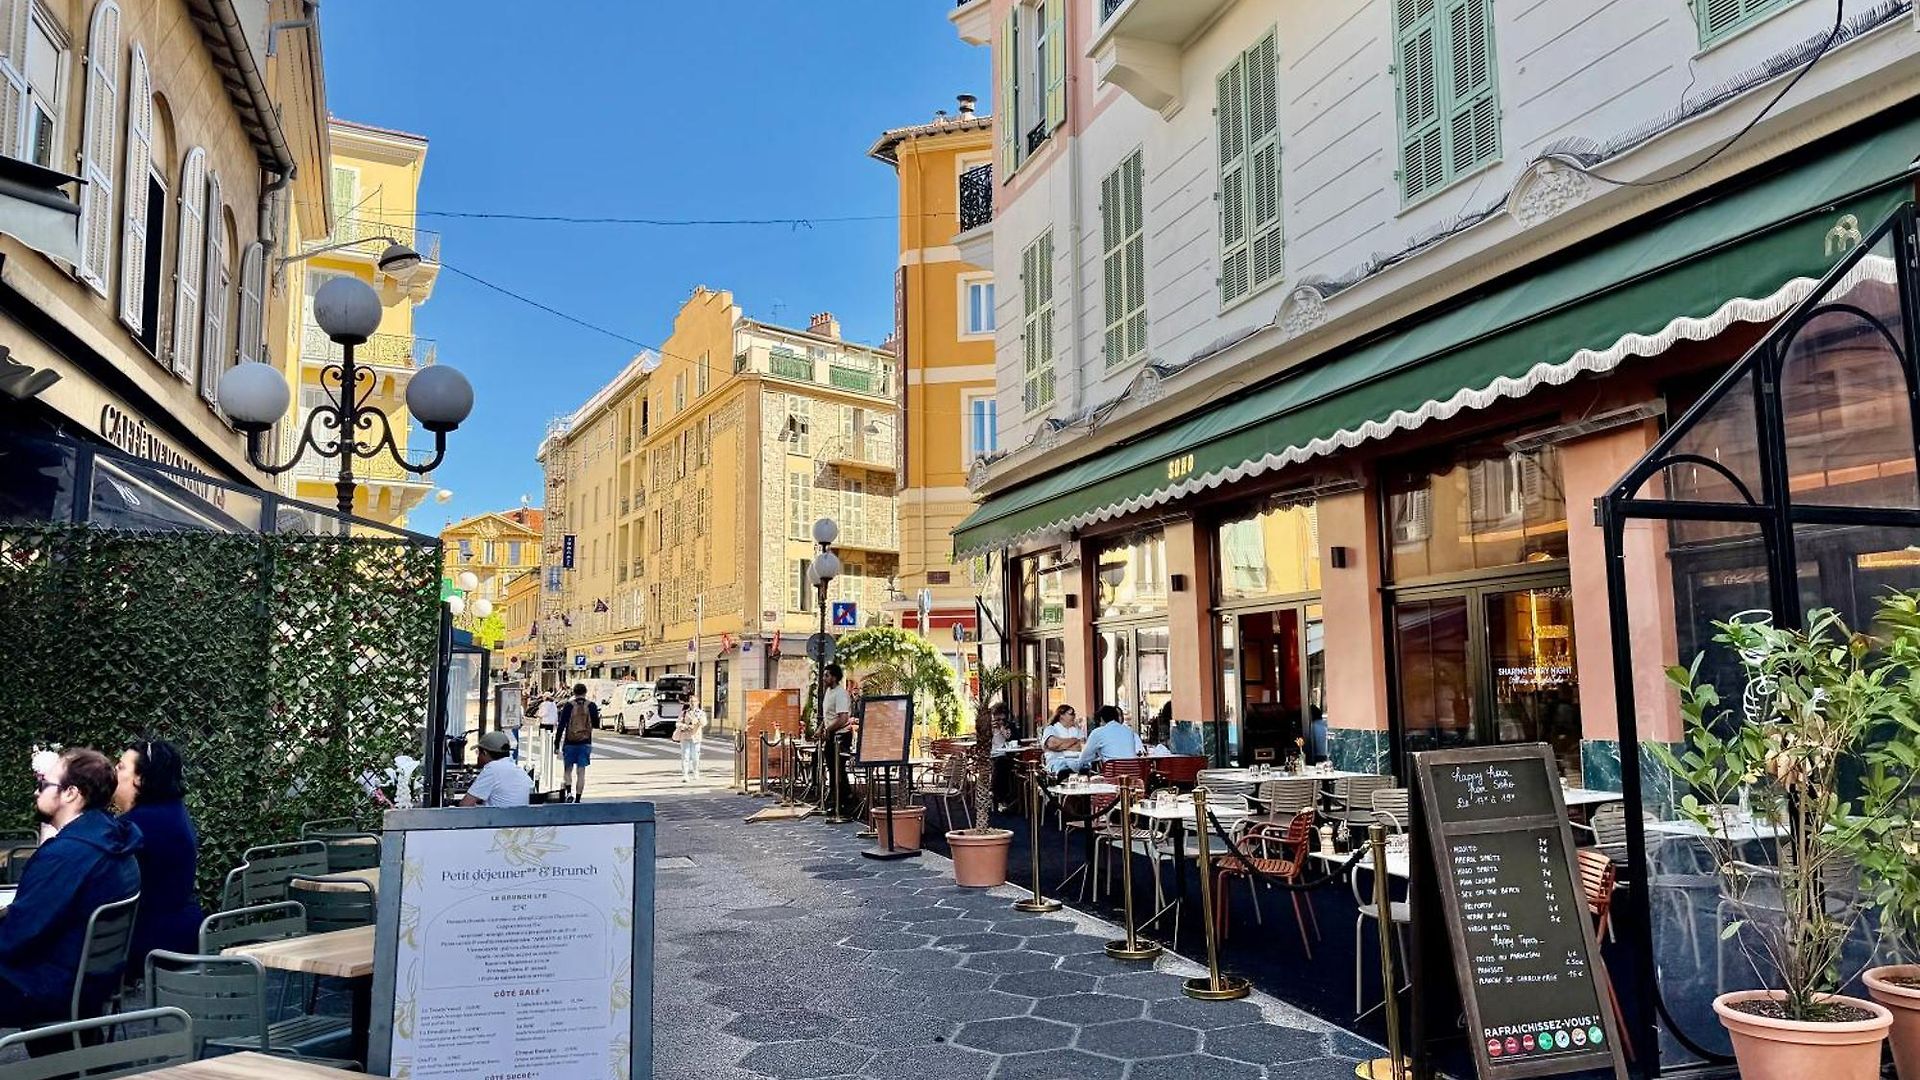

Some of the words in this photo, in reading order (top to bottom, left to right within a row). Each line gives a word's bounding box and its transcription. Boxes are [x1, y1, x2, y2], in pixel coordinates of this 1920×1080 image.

[1168, 454, 1194, 480] SOHO
[442, 870, 470, 882] Petit
[552, 864, 598, 877] Brunch
[494, 989, 517, 998] CÔTÉ
[1484, 1016, 1592, 1038] RAFRAICHISSEZ-VOUS
